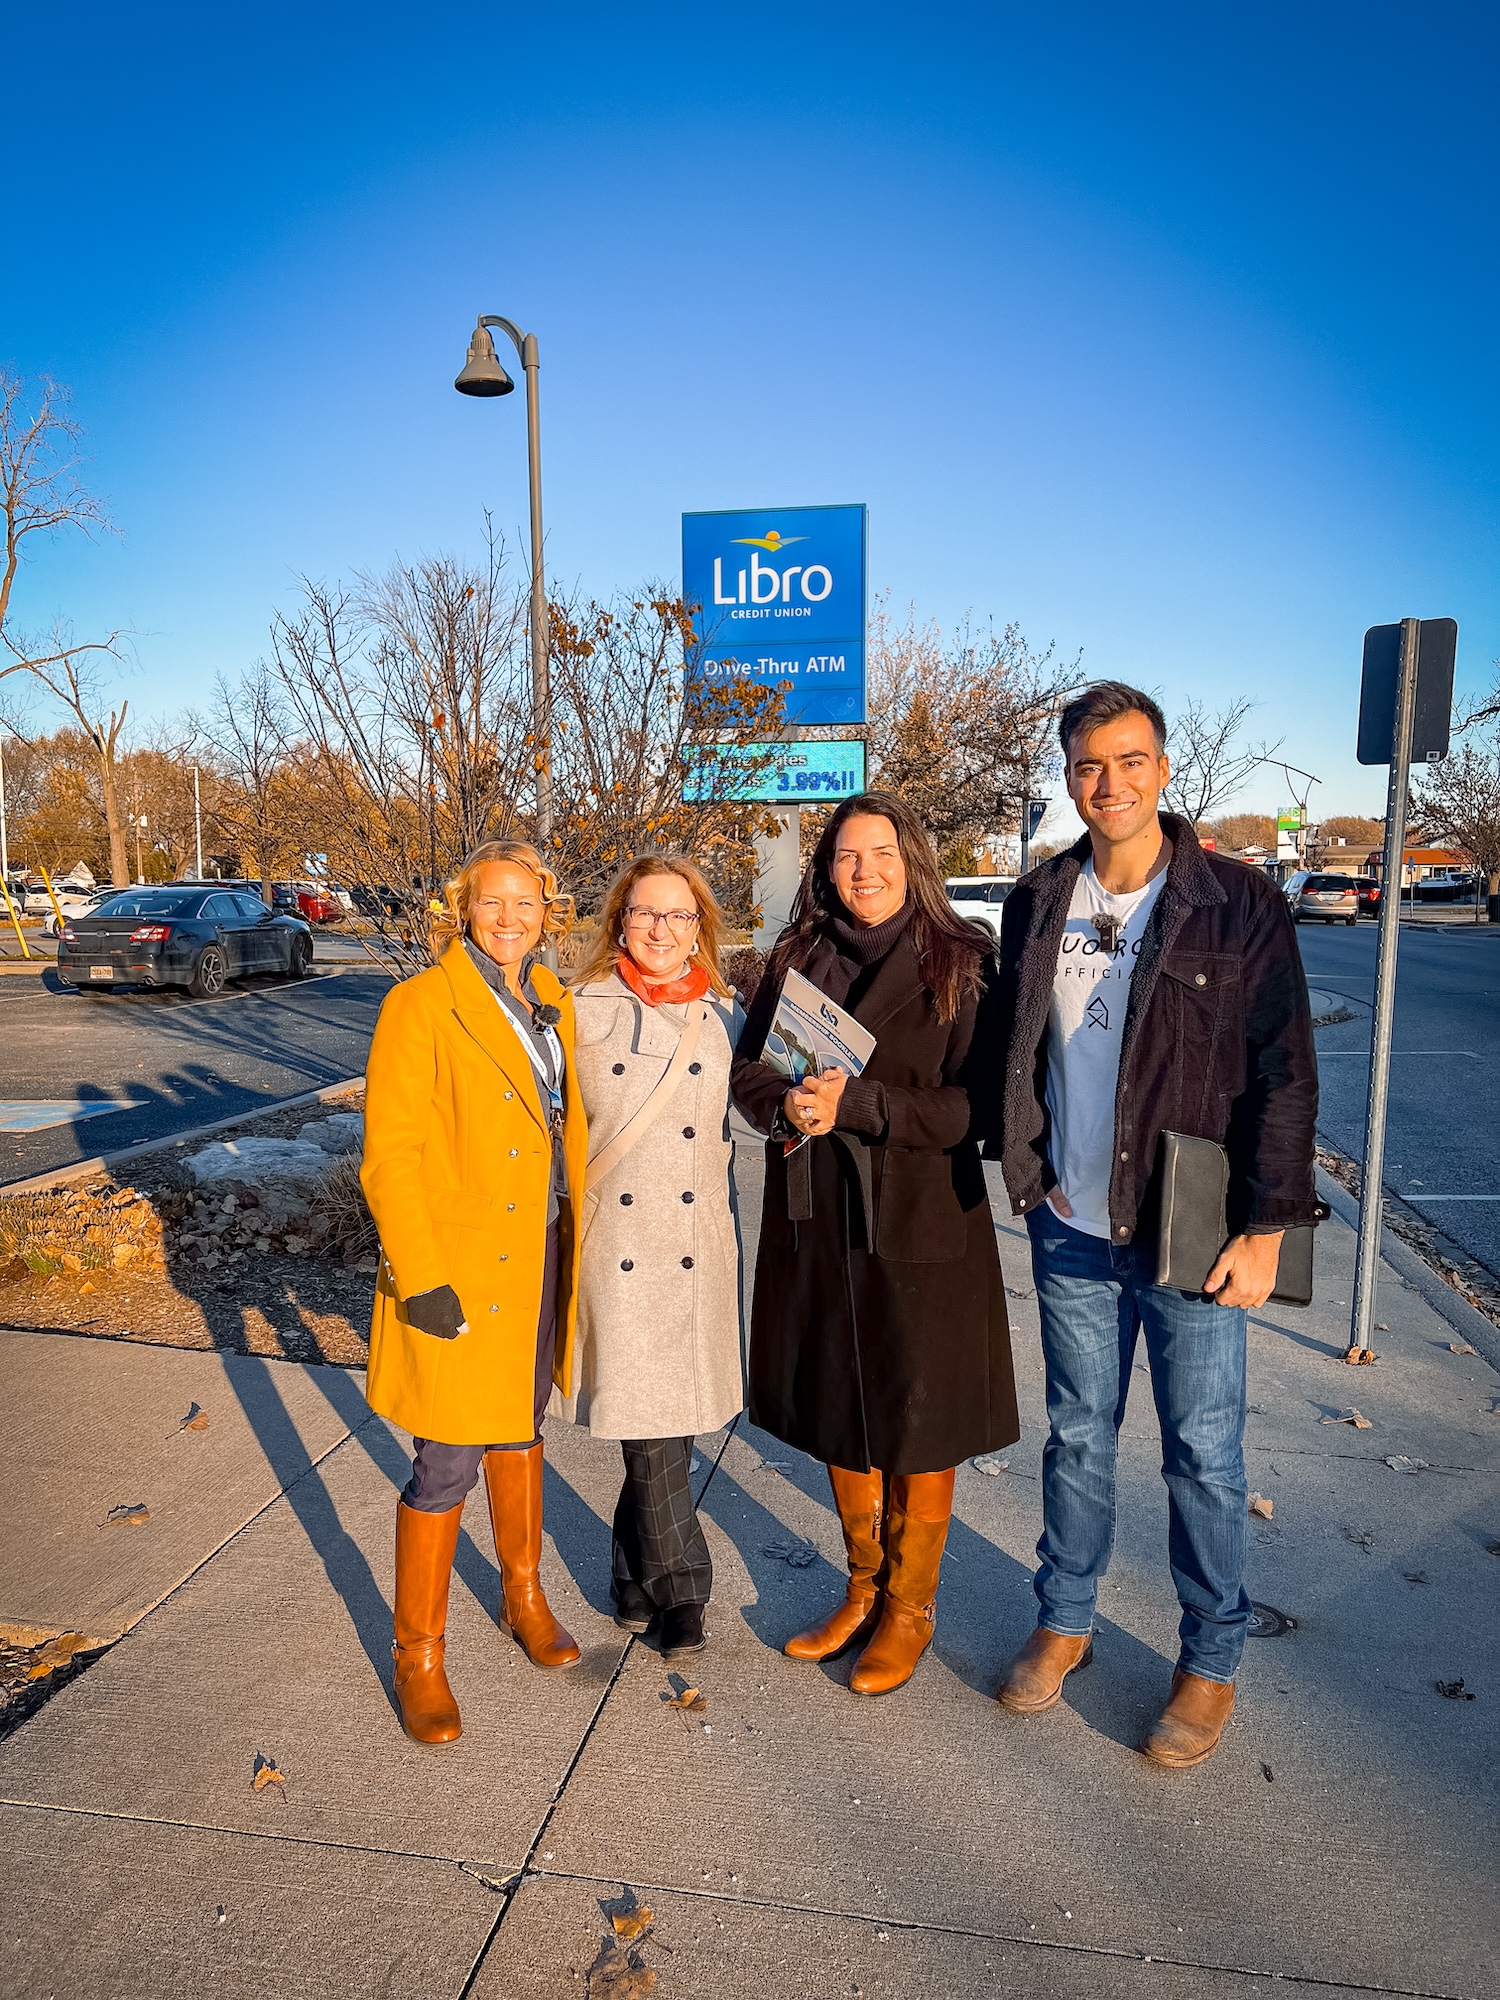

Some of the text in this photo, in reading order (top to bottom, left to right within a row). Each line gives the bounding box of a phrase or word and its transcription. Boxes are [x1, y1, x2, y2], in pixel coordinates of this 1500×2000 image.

[714, 552, 833, 605] Libro
[731, 607, 812, 619] CREDIT UNION
[704, 655, 846, 676] Drive-Thru ATM
[828, 1034, 856, 1060] BOOKLET
